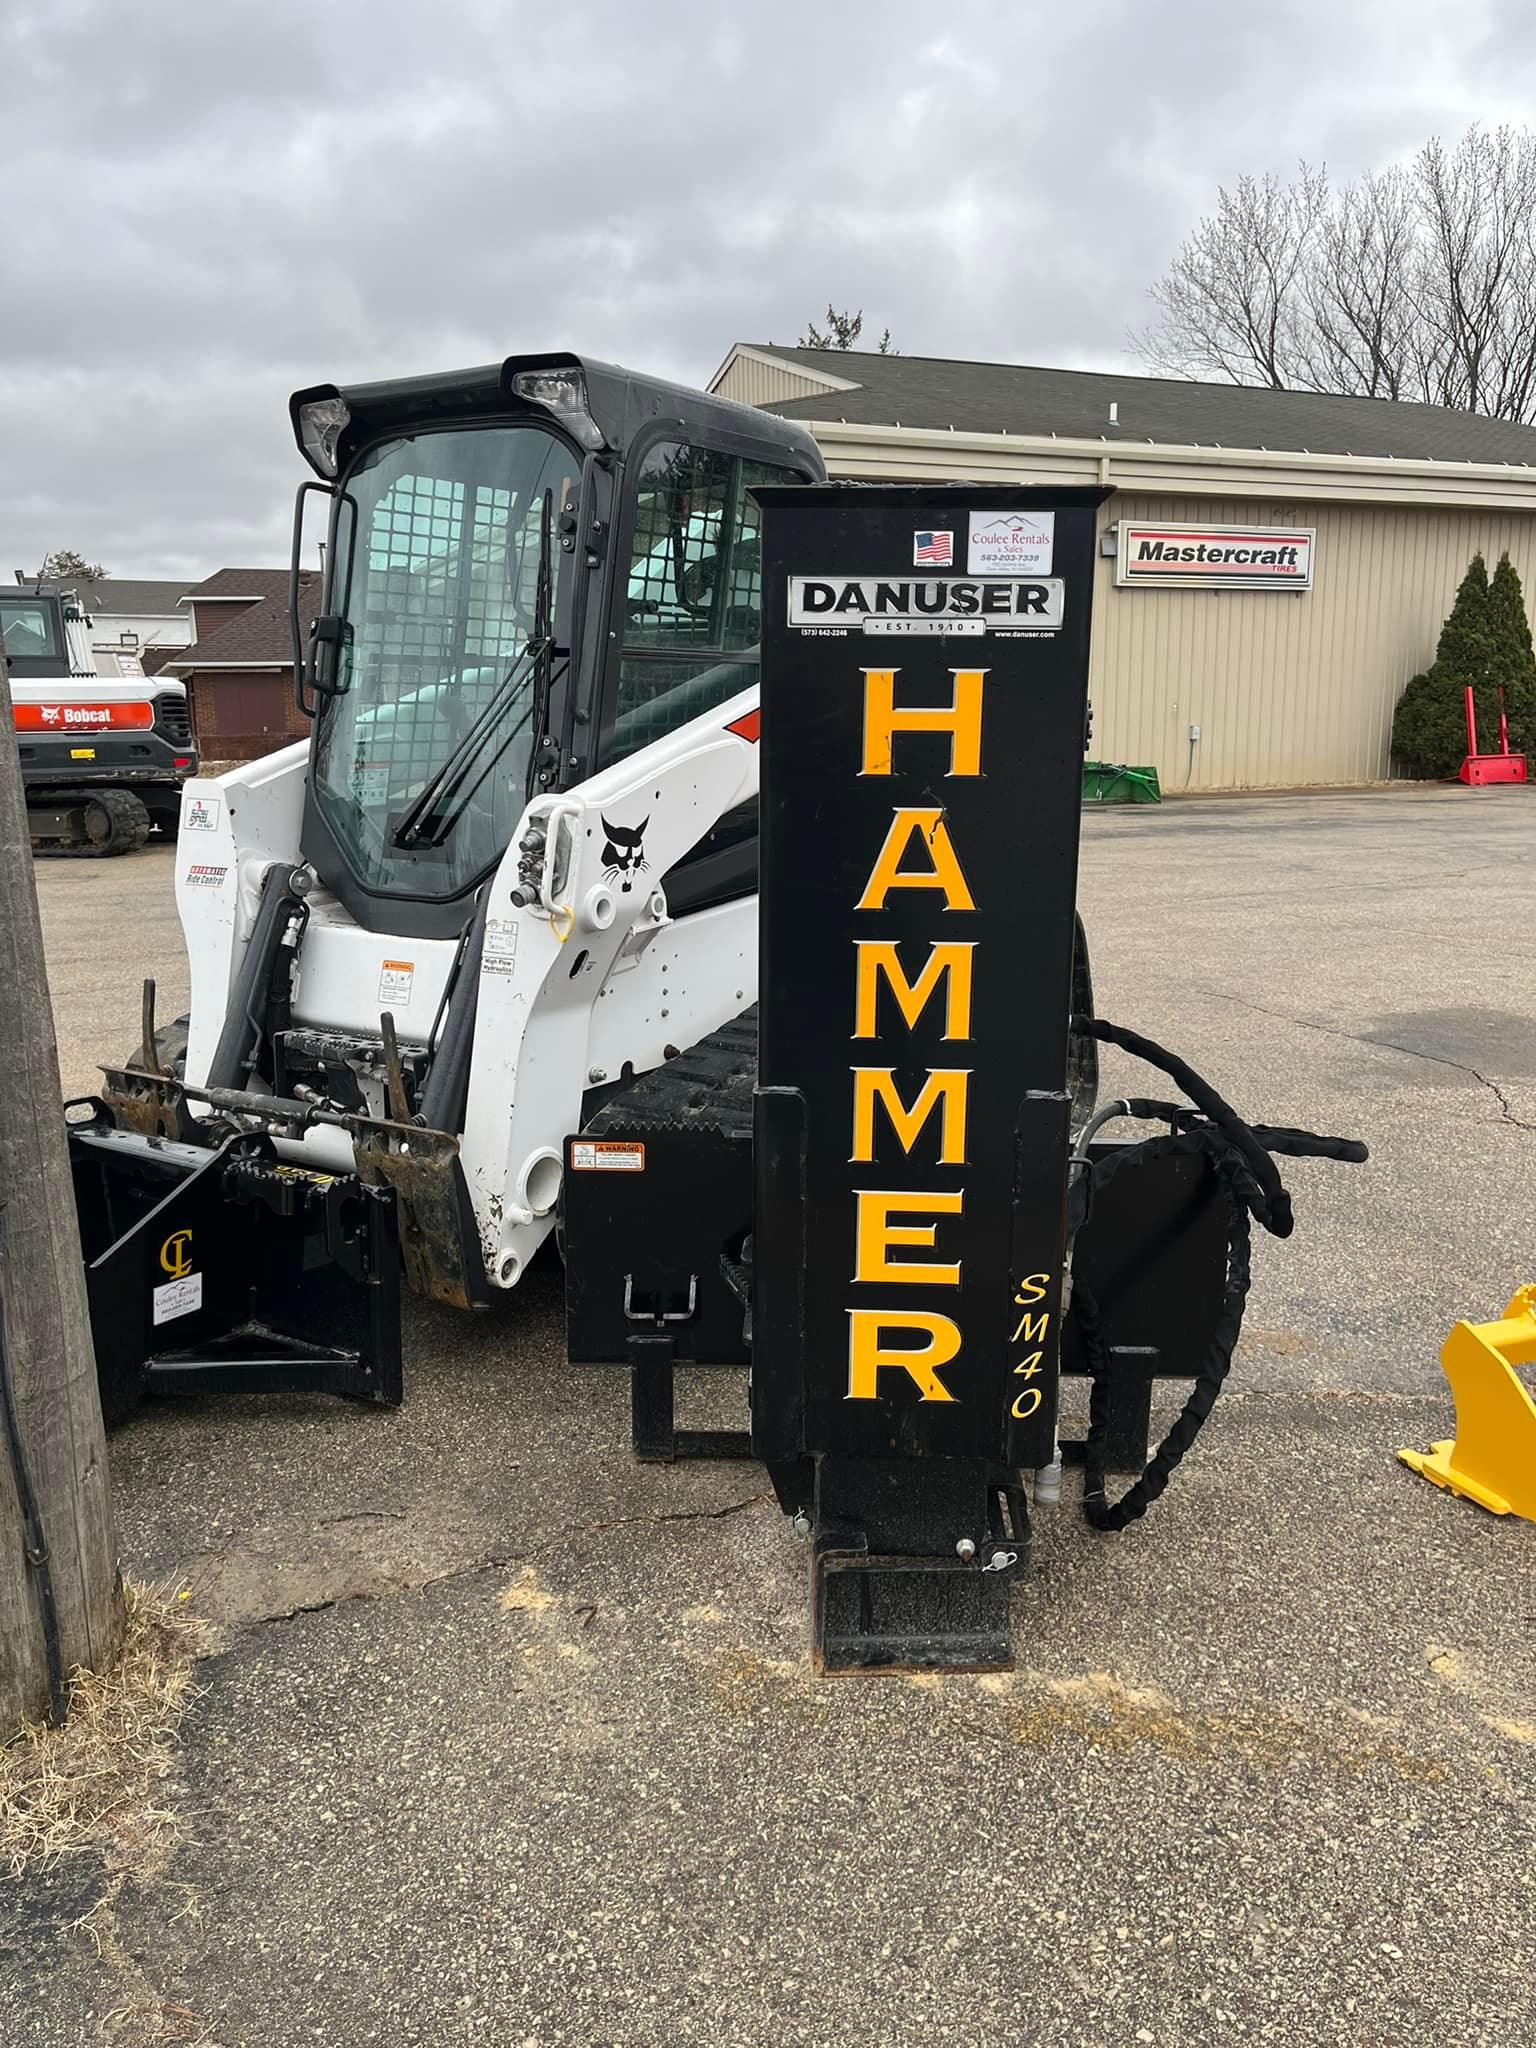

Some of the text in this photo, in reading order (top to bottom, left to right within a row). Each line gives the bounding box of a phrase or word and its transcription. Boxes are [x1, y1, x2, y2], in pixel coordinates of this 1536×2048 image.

[972, 531, 1050, 545] Coulee Rentals
[1003, 545, 1024, 553] Sales
[1138, 541, 1298, 566] Mastercraft
[980, 554, 1040, 562] 563-203-7339
[1272, 564, 1297, 573] TIRES
[802, 582, 1051, 615] DANUSER
[801, 628, 818, 636] (573)
[886, 622, 964, 632] EST. 1910
[994, 631, 1055, 639] www.danuser.com
[64, 708, 111, 723] Bobcat
[186, 874, 224, 885] Ride Control
[843, 667, 992, 1403] HAMMER
[606, 1145, 640, 1153] WARNING
[1010, 1272, 1051, 1420] SM40
